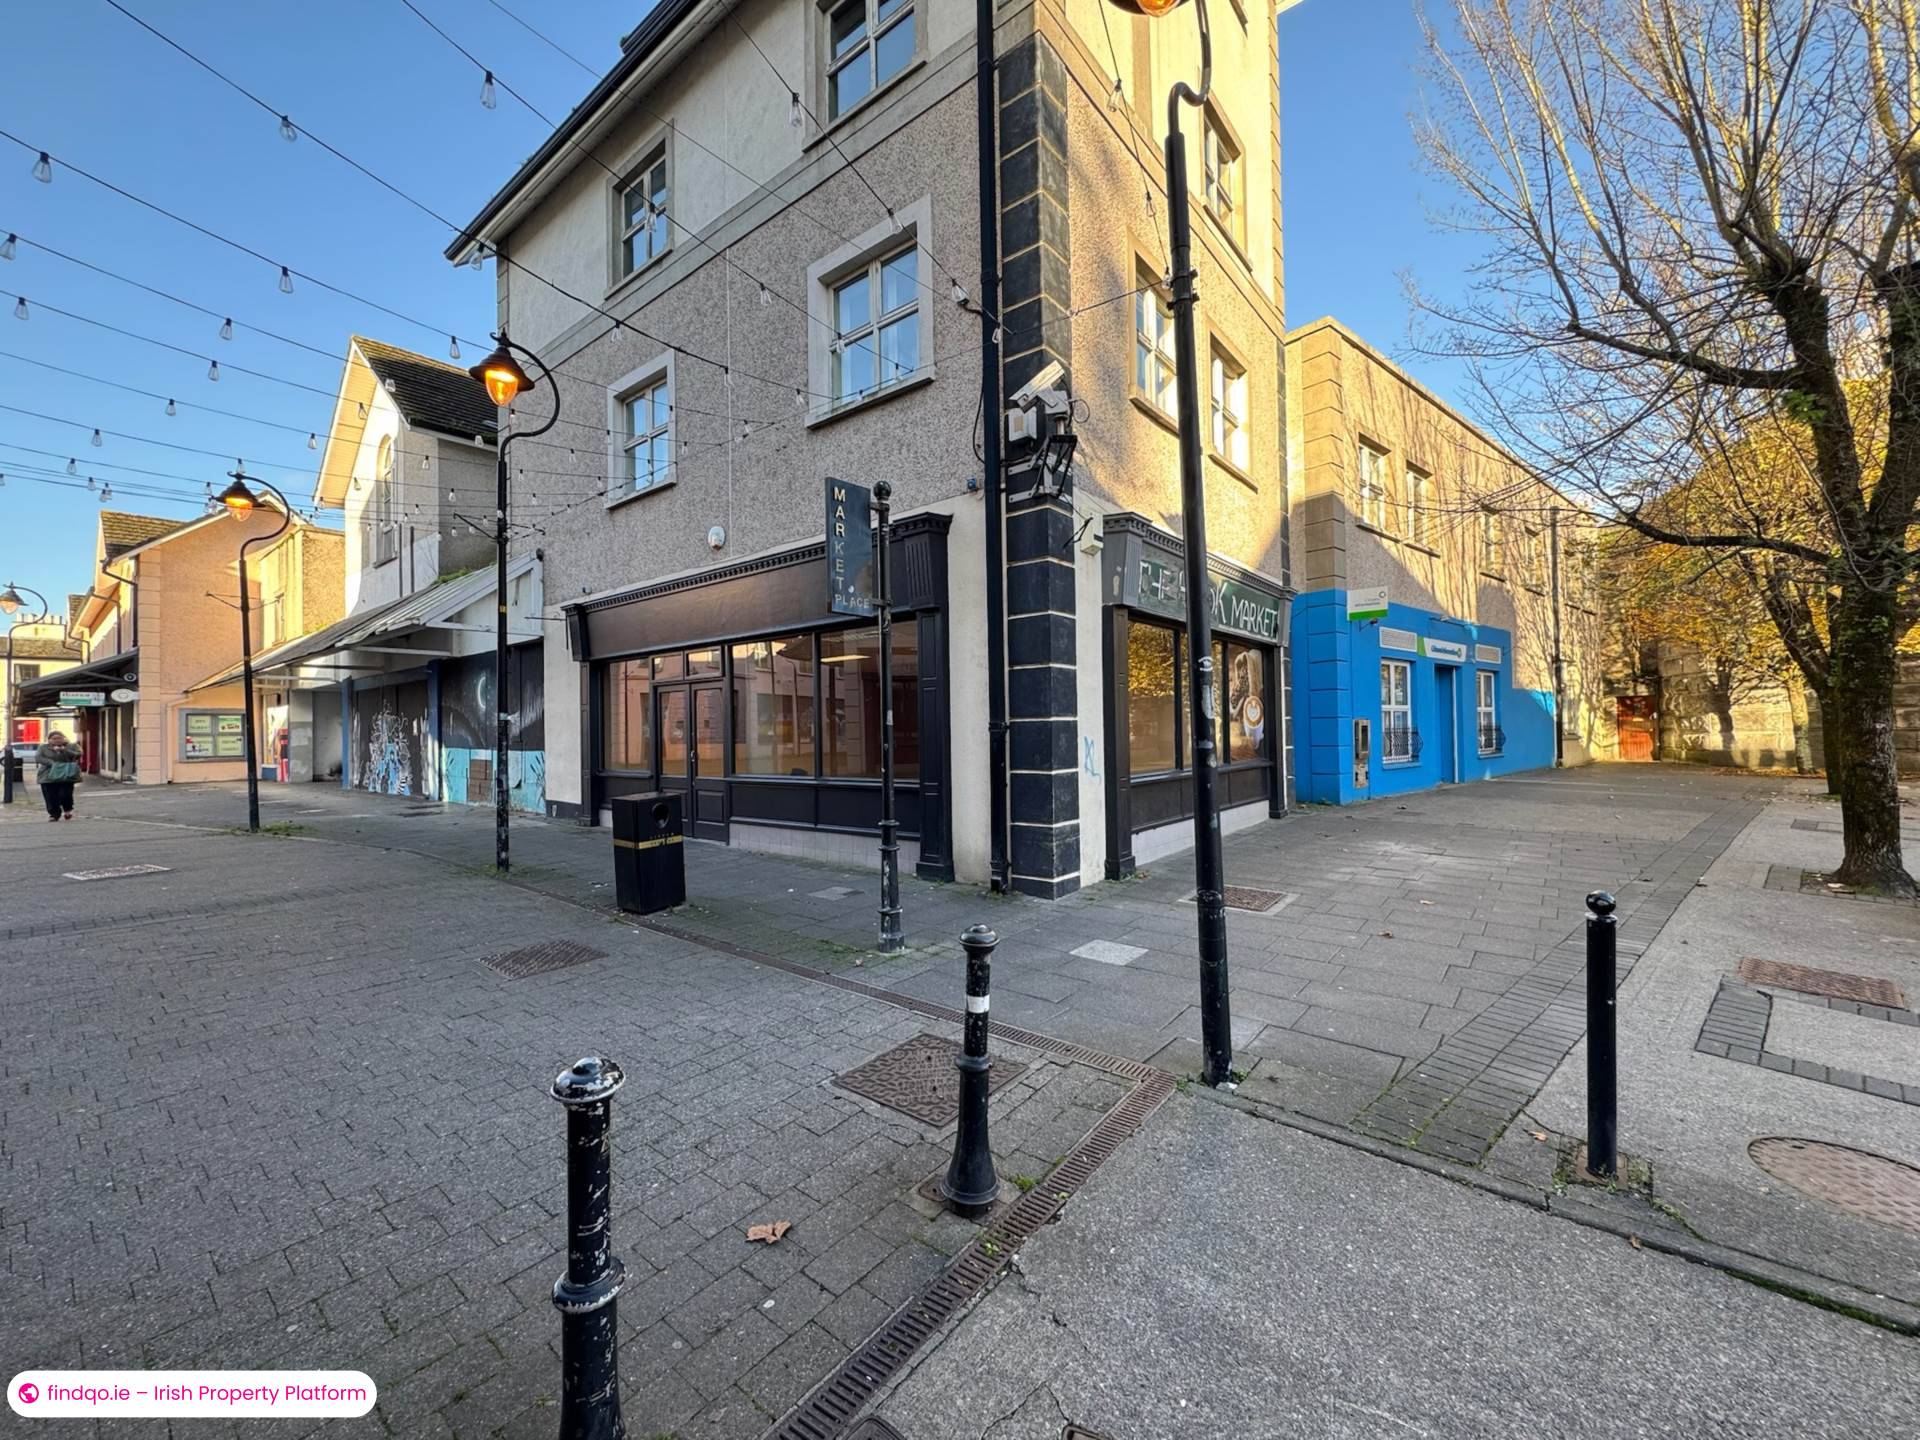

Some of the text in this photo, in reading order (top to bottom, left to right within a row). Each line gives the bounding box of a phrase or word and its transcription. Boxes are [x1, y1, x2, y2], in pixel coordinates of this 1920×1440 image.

[834, 486, 846, 590] MARKET
[834, 594, 870, 609] PLACE
[1231, 595, 1277, 637] MARKET
